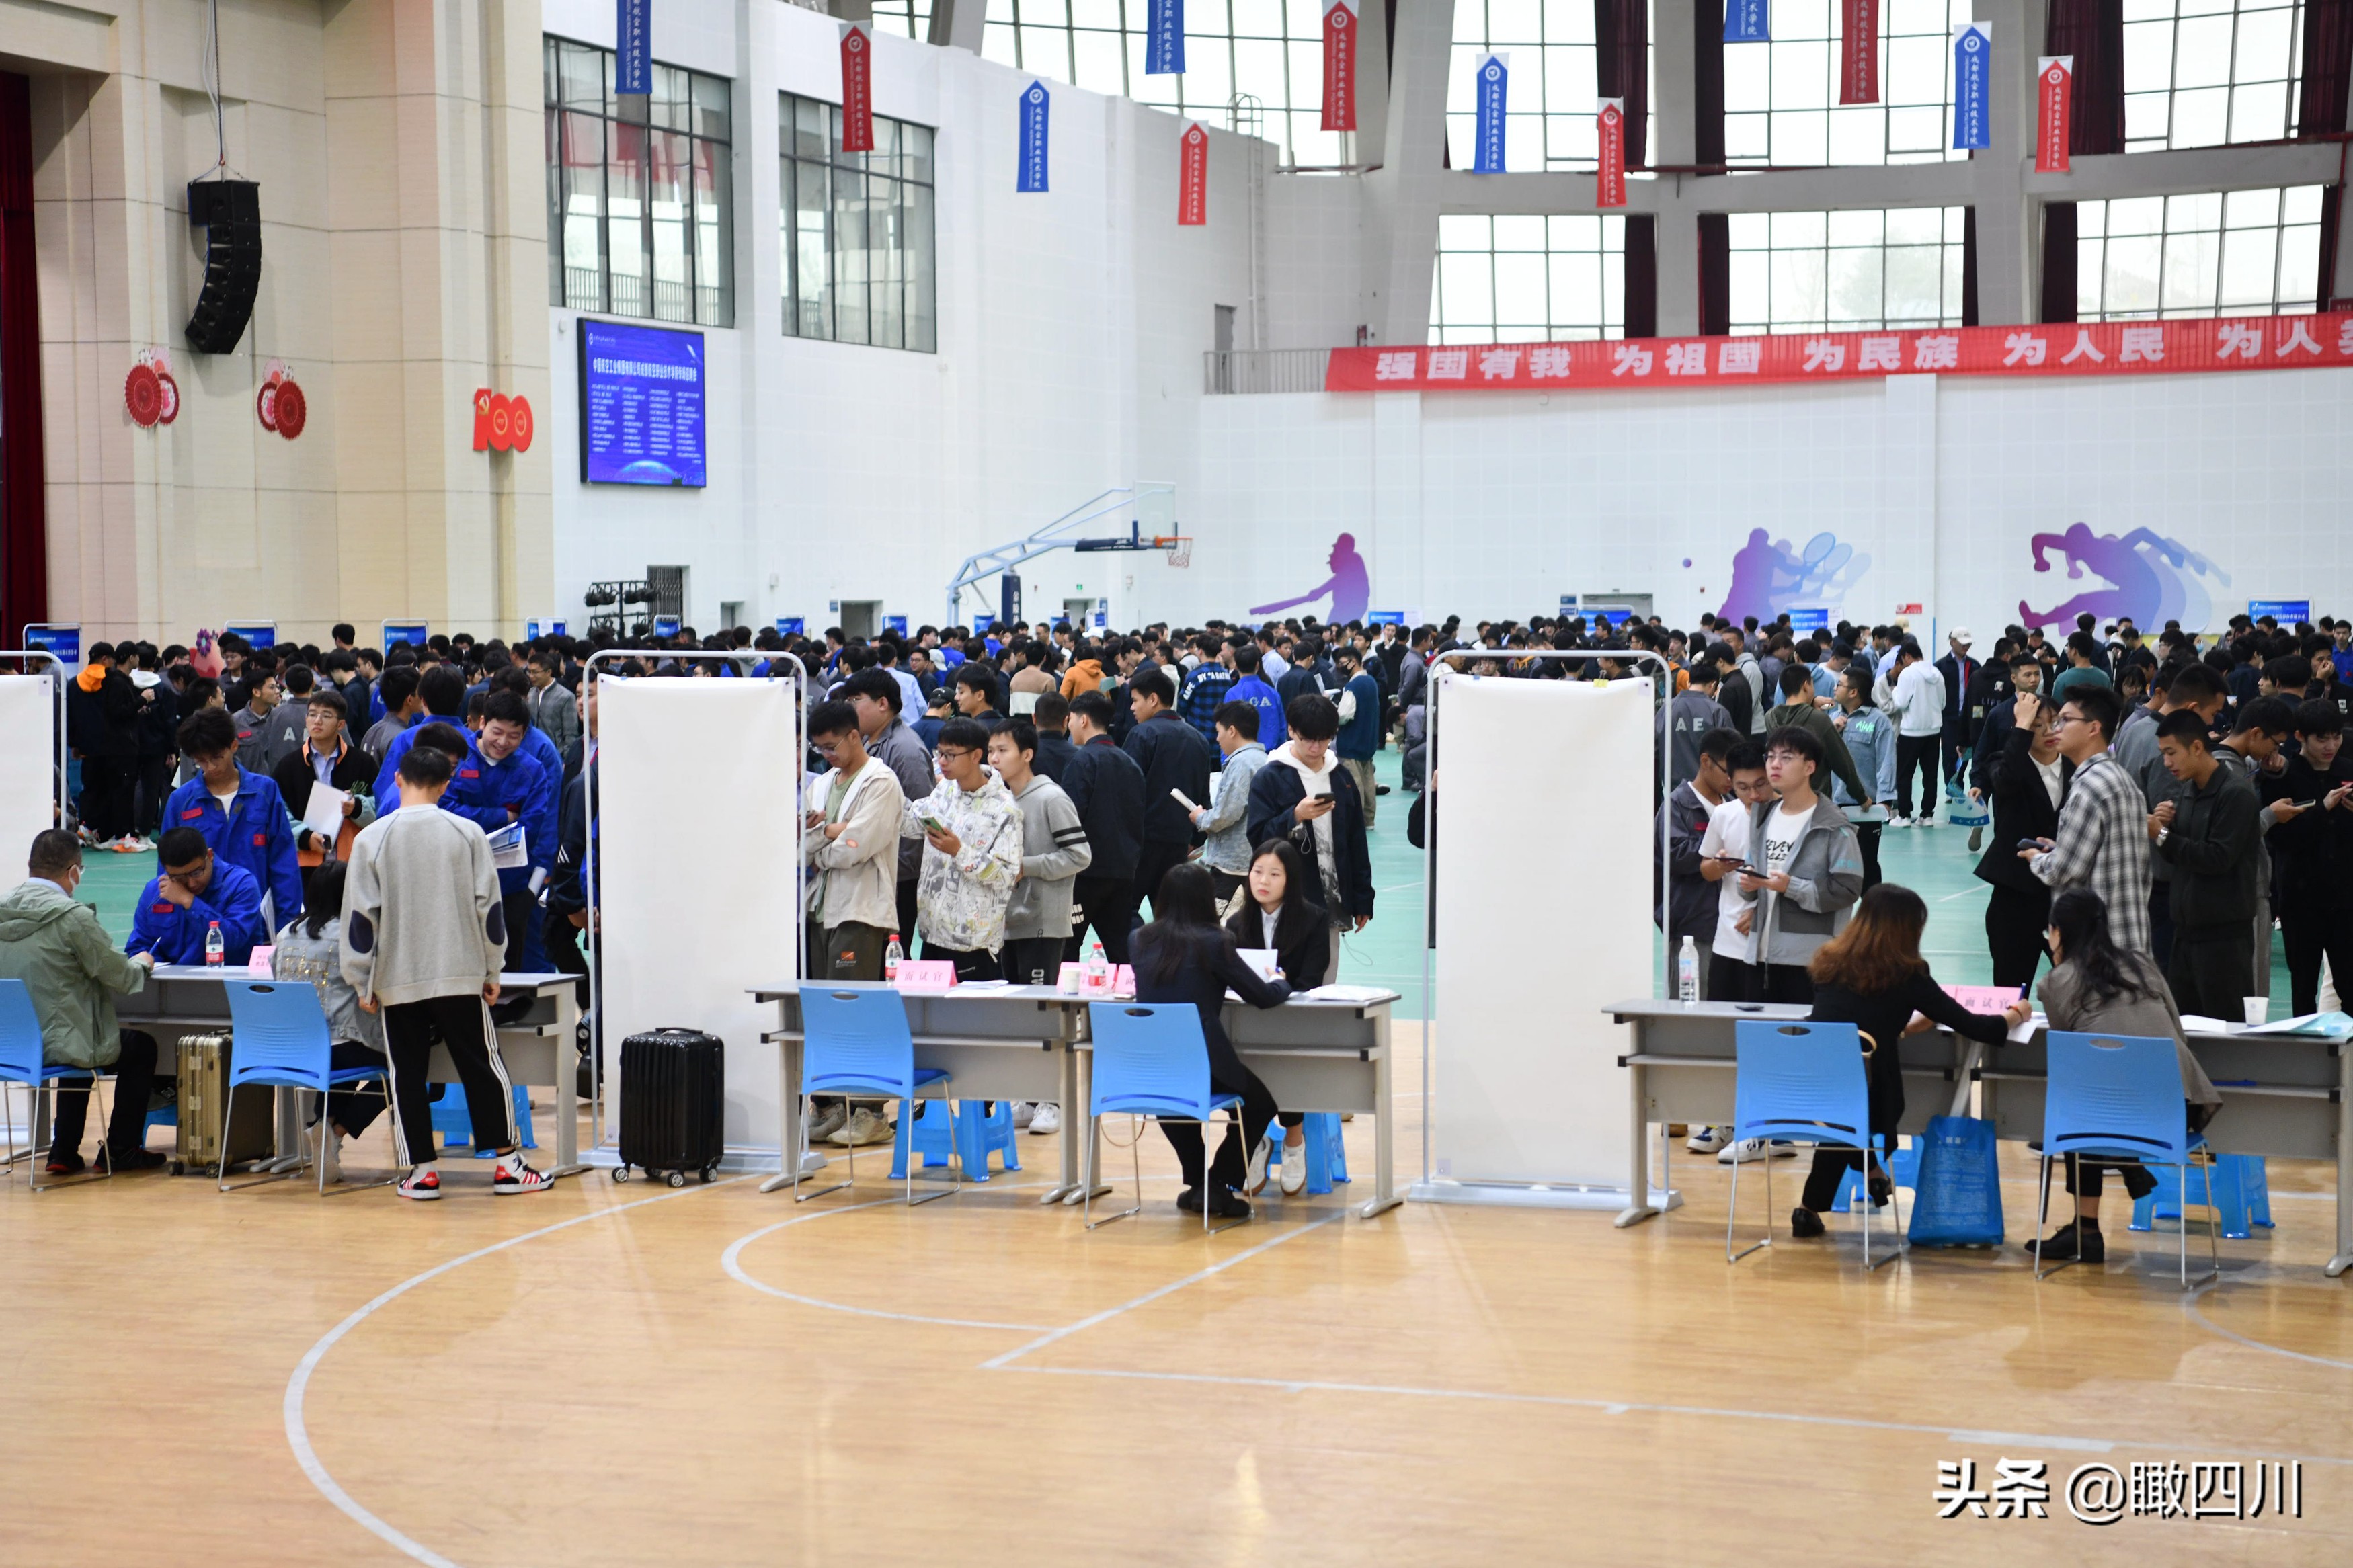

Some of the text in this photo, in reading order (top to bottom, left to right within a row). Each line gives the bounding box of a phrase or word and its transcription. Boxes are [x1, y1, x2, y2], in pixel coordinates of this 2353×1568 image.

[1375, 345, 1571, 381] 强国有我
[1613, 341, 1761, 376] 为祖国
[1804, 335, 1958, 372] 为民族
[2003, 326, 2165, 367] 为人民
[904, 971, 943, 982] 面试官
[1964, 996, 2009, 1009] 面试官
